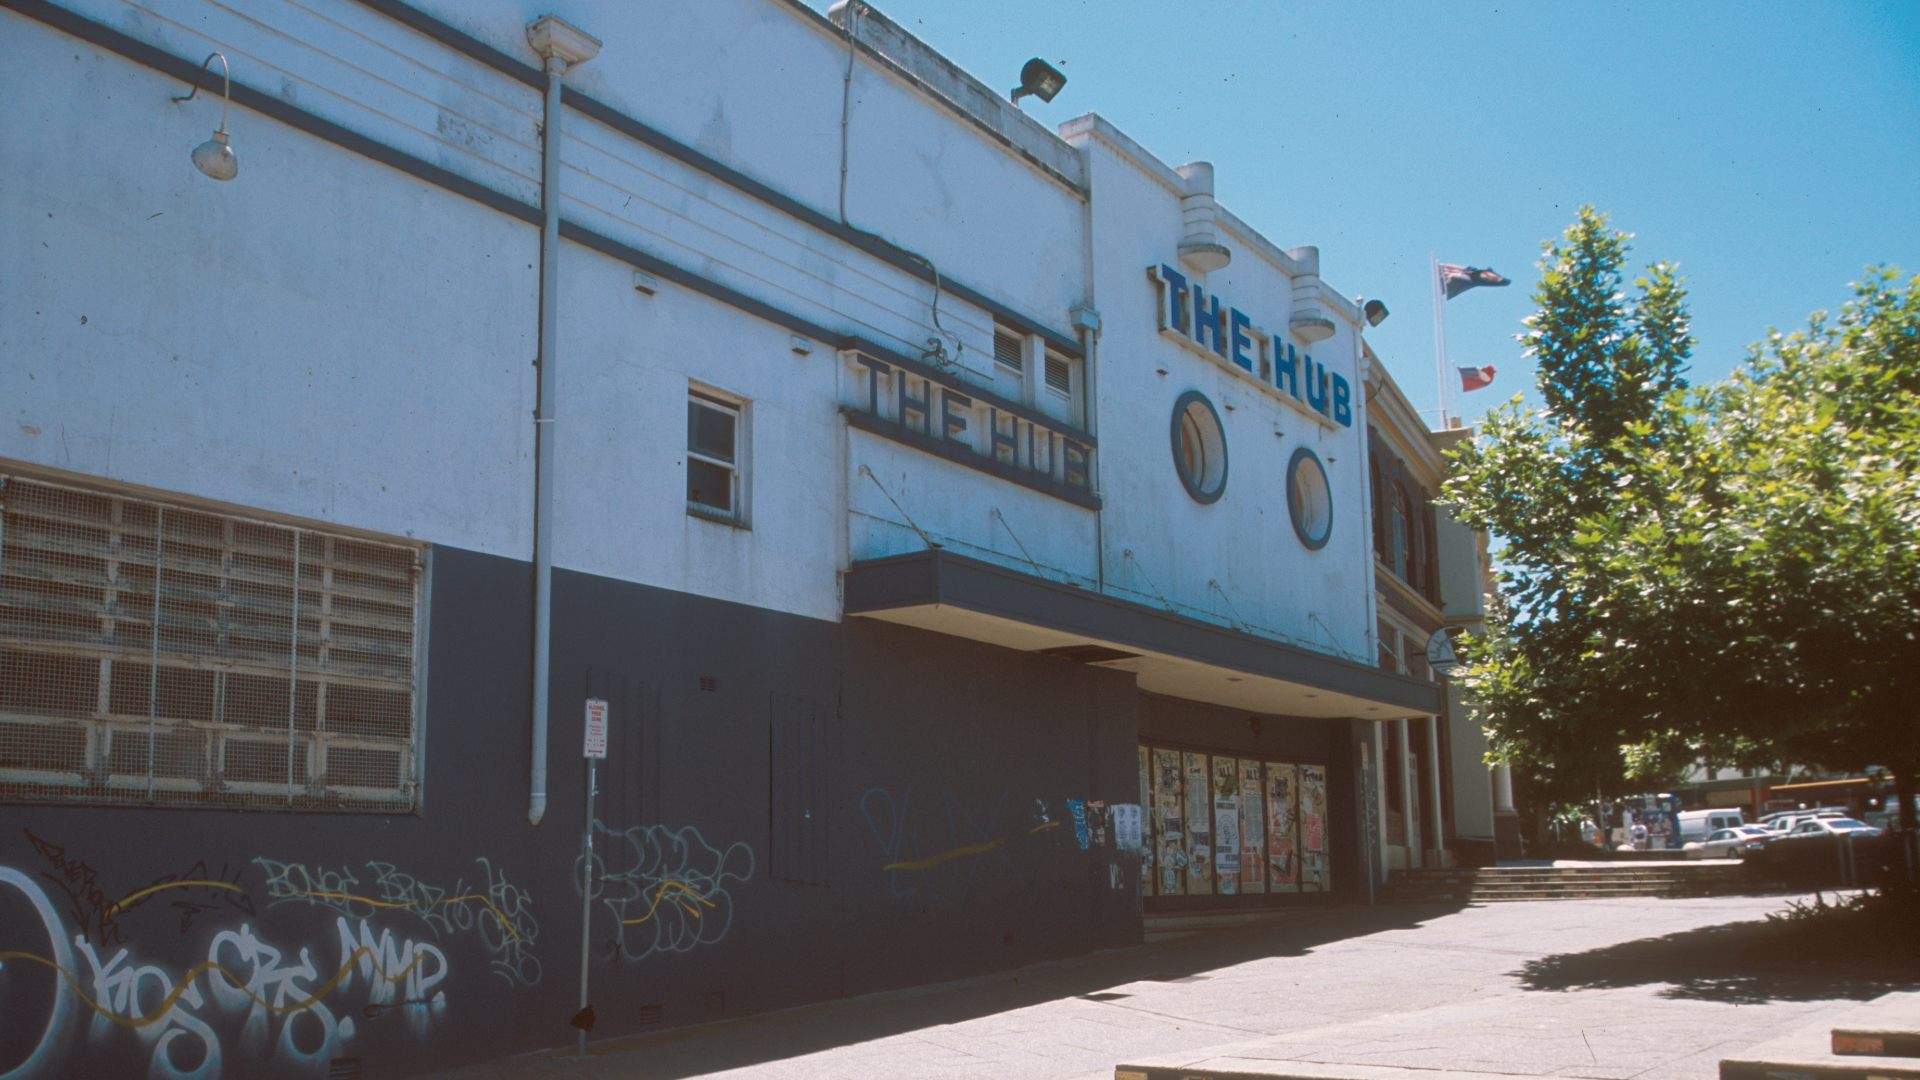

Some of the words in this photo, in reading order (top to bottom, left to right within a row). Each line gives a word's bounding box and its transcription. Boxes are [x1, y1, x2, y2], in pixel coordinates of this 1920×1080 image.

[1159, 263, 1254, 374] THE
[1273, 334, 1351, 428] HUB
[856, 352, 973, 452] THE
[989, 405, 1090, 496] HUB
